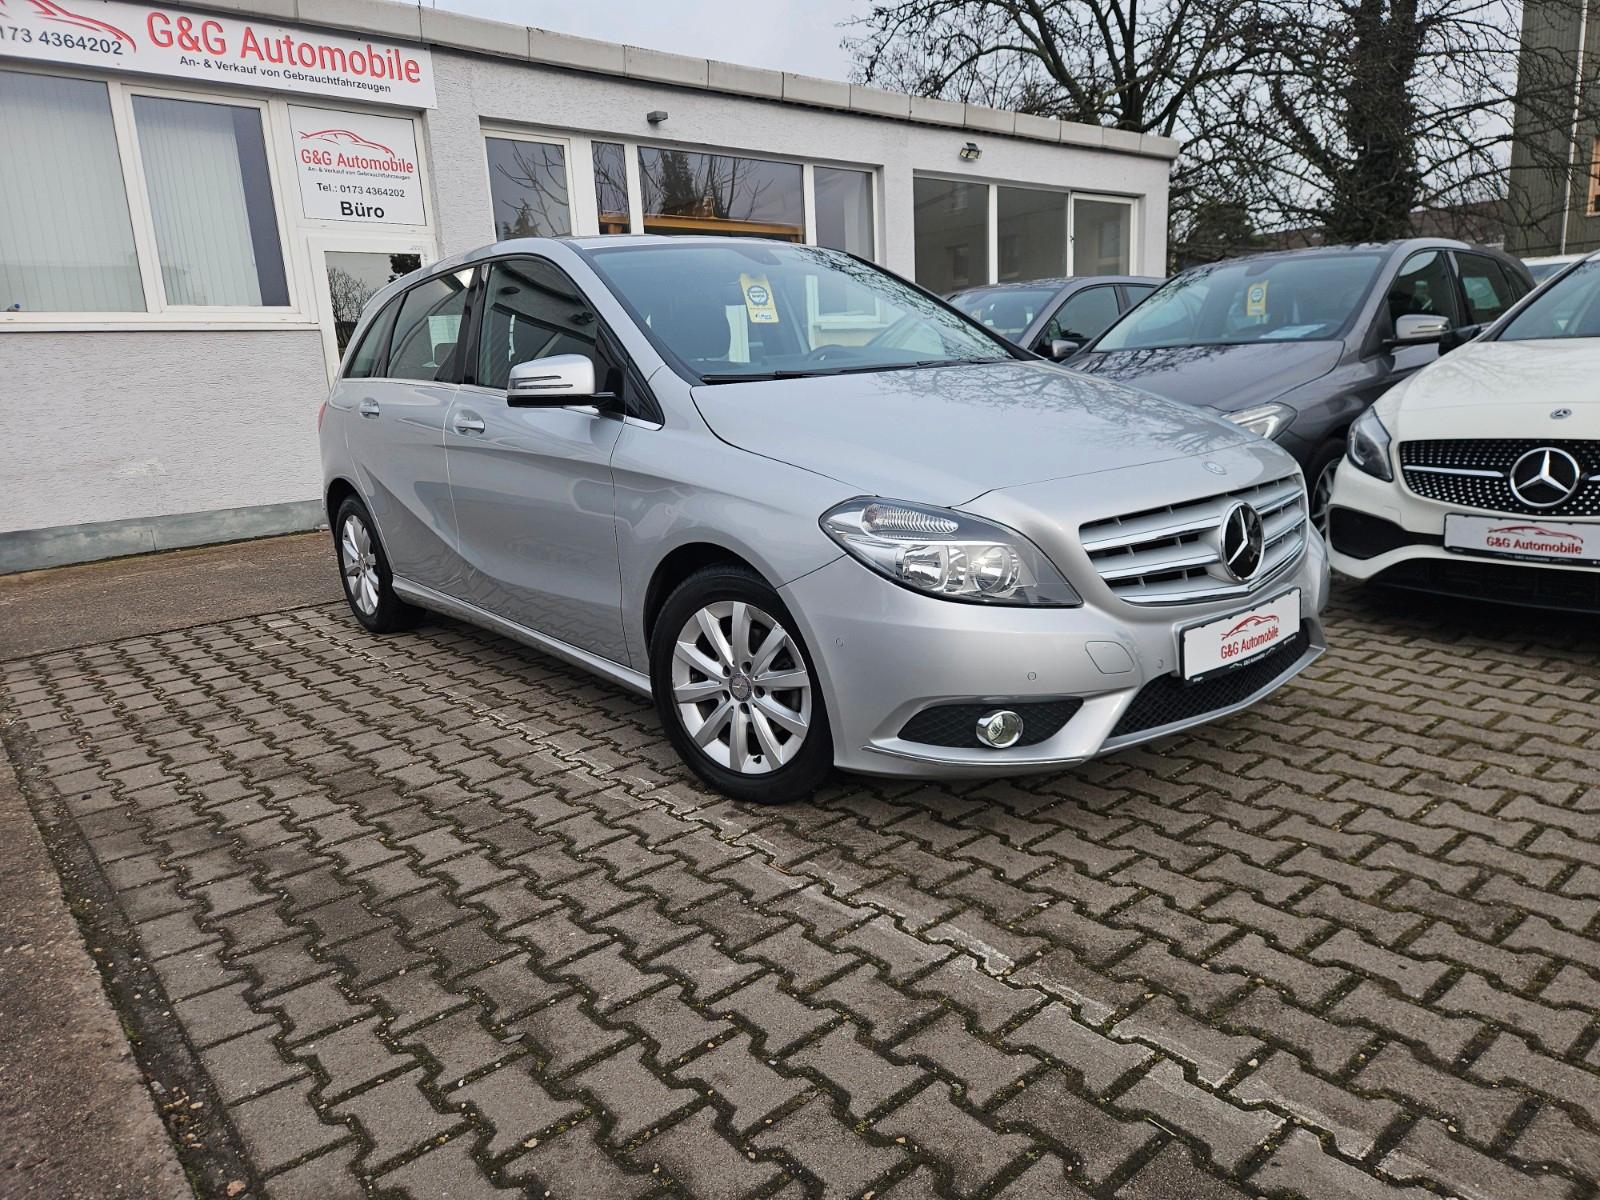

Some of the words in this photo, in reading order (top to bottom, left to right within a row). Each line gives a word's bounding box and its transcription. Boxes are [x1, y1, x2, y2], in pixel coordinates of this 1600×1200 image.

[39, 31, 123, 55] 4364202
[147, 11, 227, 55] G&G
[240, 26, 421, 83] Automobile
[180, 55, 200, 66] An-
[203, 58, 212, 69] &
[215, 60, 257, 75] Verkauf
[260, 67, 280, 78] von
[283, 69, 391, 93] Gebrauchtfahrzeugen
[301, 149, 332, 165] G&G
[337, 153, 414, 173] Automobile
[316, 182, 338, 192] Tel.:
[340, 184, 363, 195] 0173
[366, 187, 406, 198] 4364202
[340, 201, 385, 218] Büro
[1486, 536, 1511, 548] G&G
[1513, 539, 1583, 554] Automobile
[1220, 641, 1239, 659] G&G
[1241, 625, 1279, 652] Automobile
